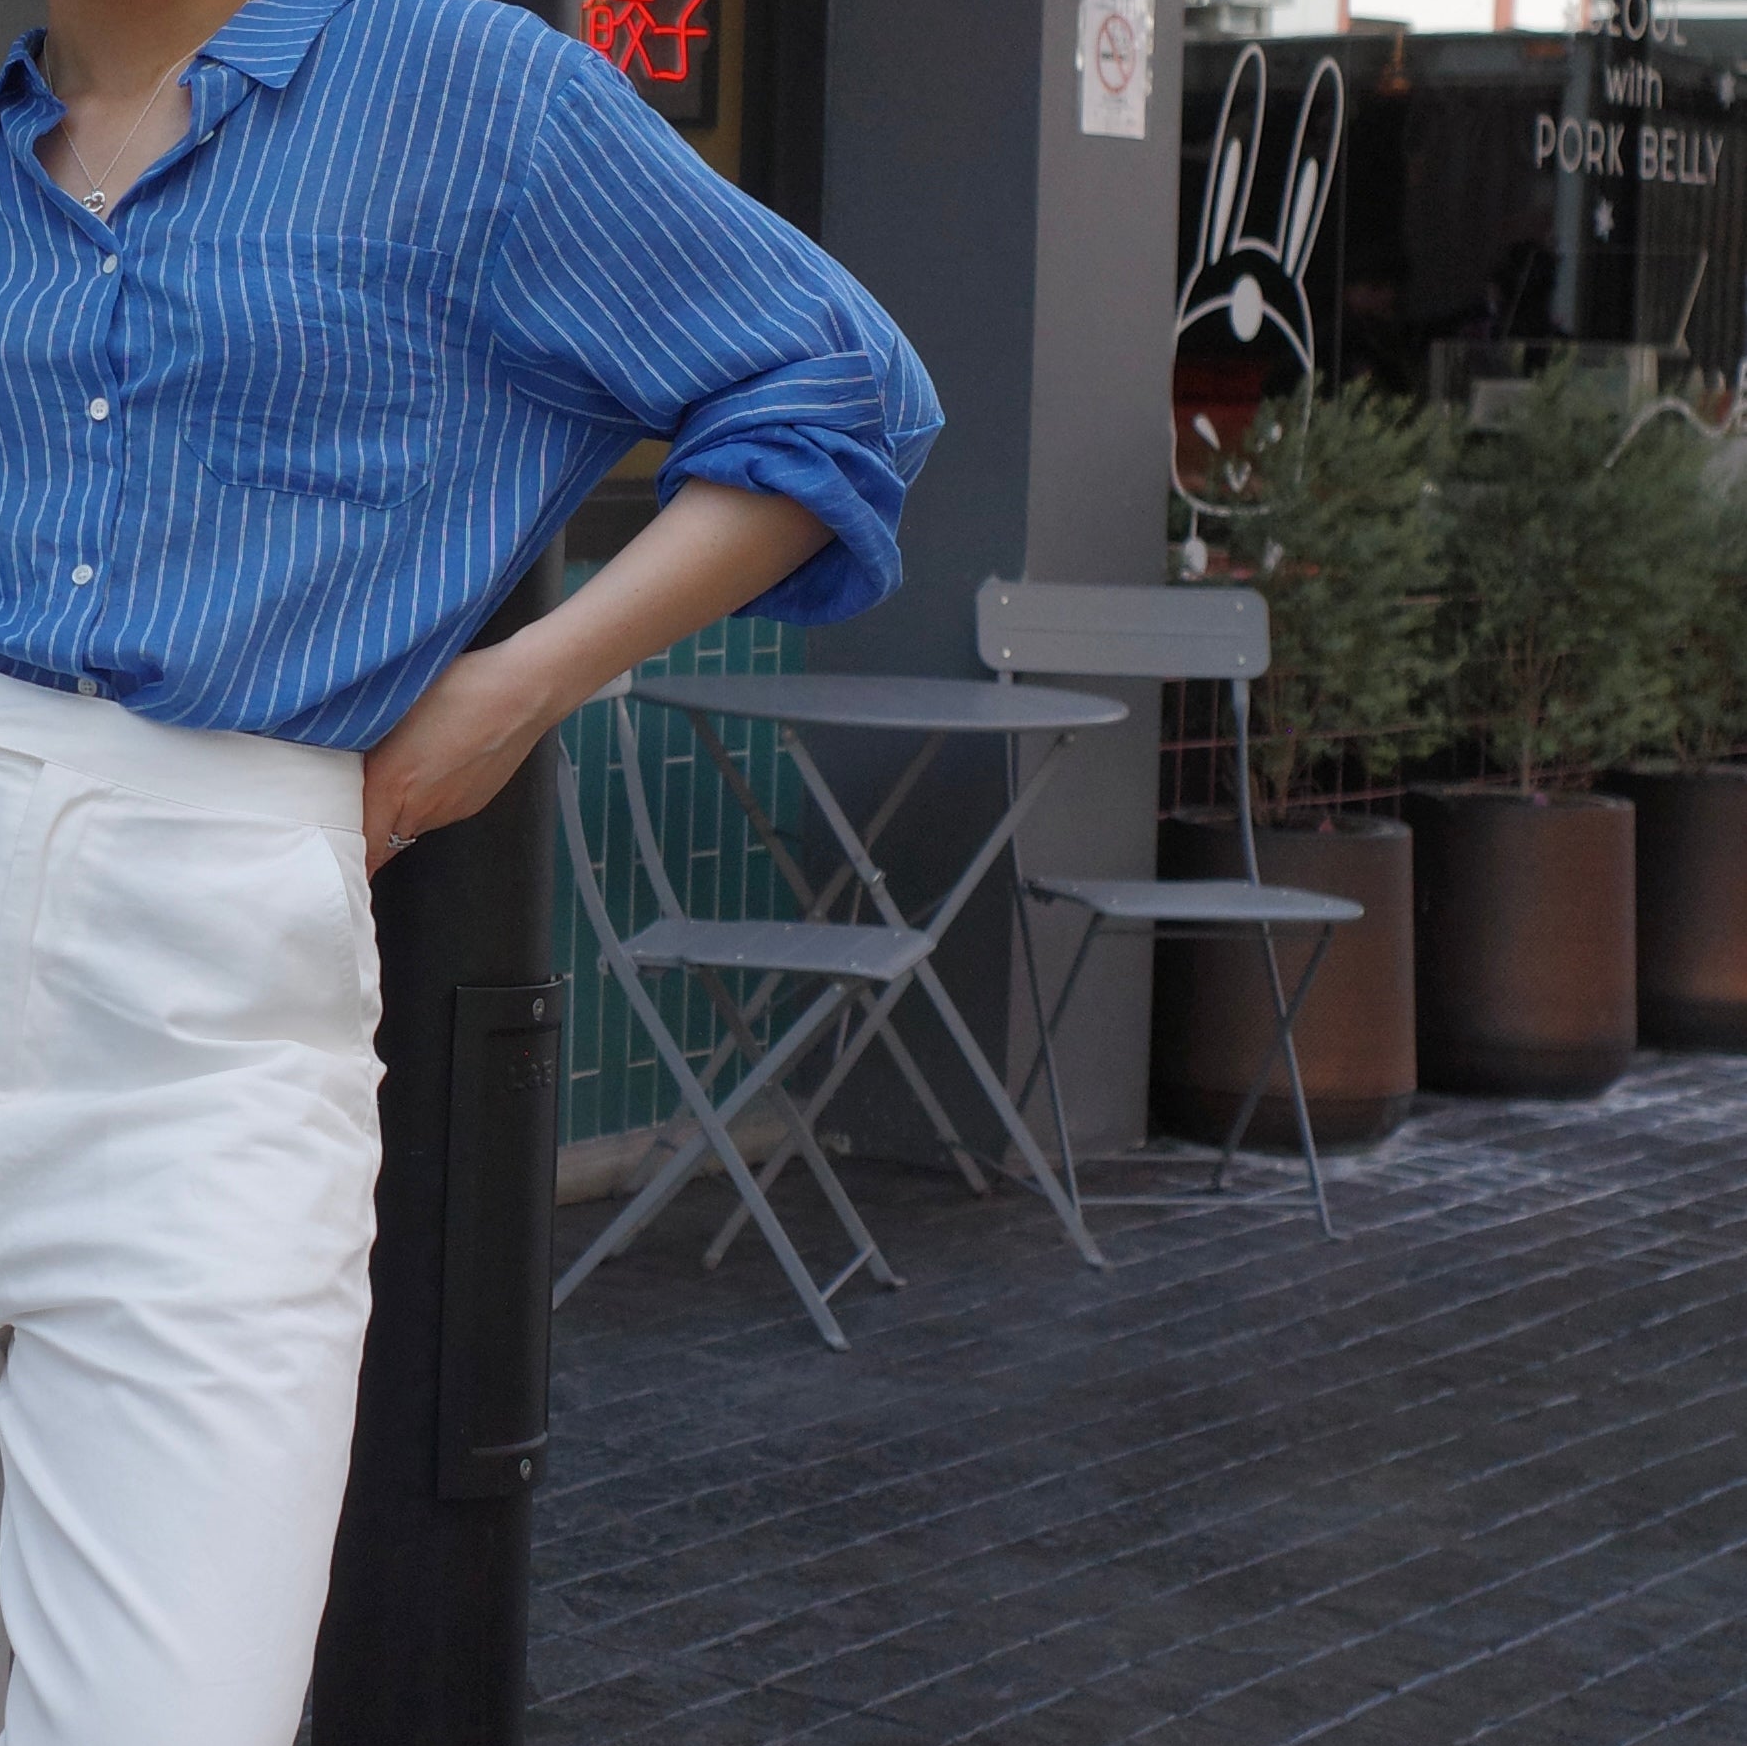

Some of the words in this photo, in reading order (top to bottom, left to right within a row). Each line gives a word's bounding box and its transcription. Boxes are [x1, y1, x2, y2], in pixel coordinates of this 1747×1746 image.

[1605, 57, 1663, 109] with
[1535, 113, 1626, 178] PORK
[1637, 124, 1724, 187] BELLY
